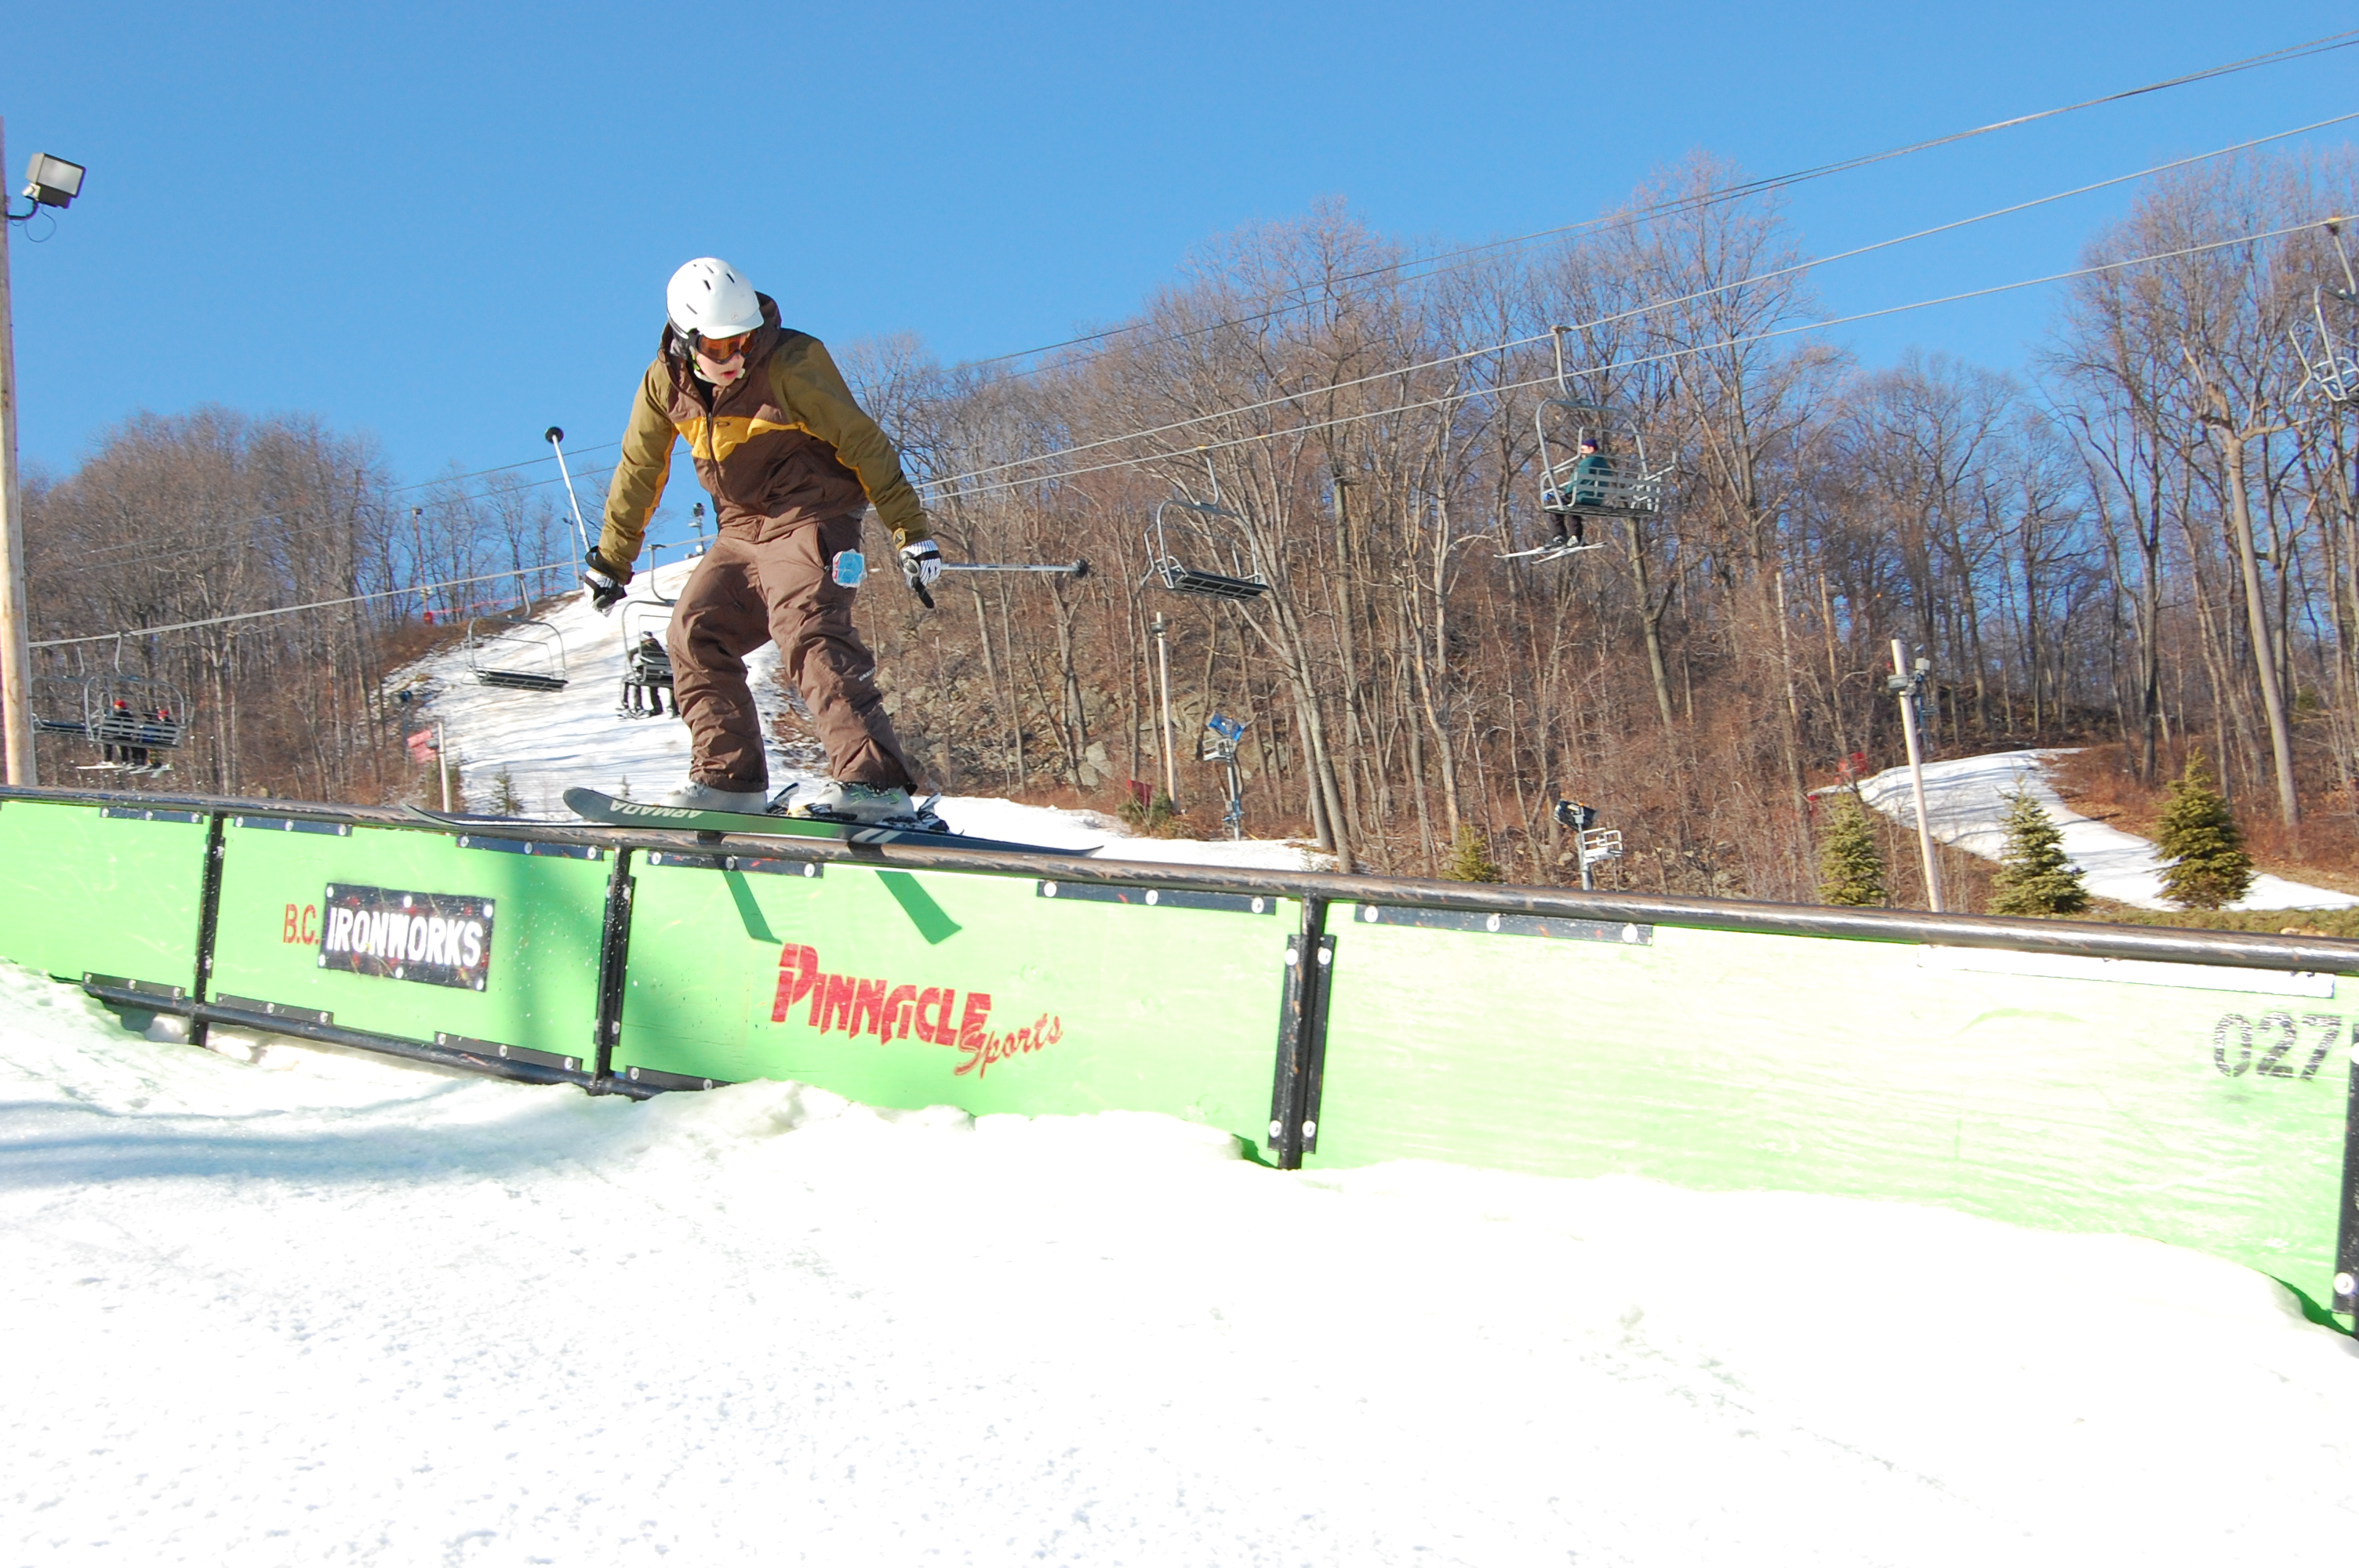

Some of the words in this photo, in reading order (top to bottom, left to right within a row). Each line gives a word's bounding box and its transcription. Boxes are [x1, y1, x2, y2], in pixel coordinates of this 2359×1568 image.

[609, 800, 704, 818] ARMADA
[283, 903, 320, 946] B.C.
[326, 906, 484, 967] IRONWORKS
[771, 942, 992, 1046] PINNACLE
[954, 1012, 1063, 1080] Sports
[2213, 1011, 2343, 1083] 027
